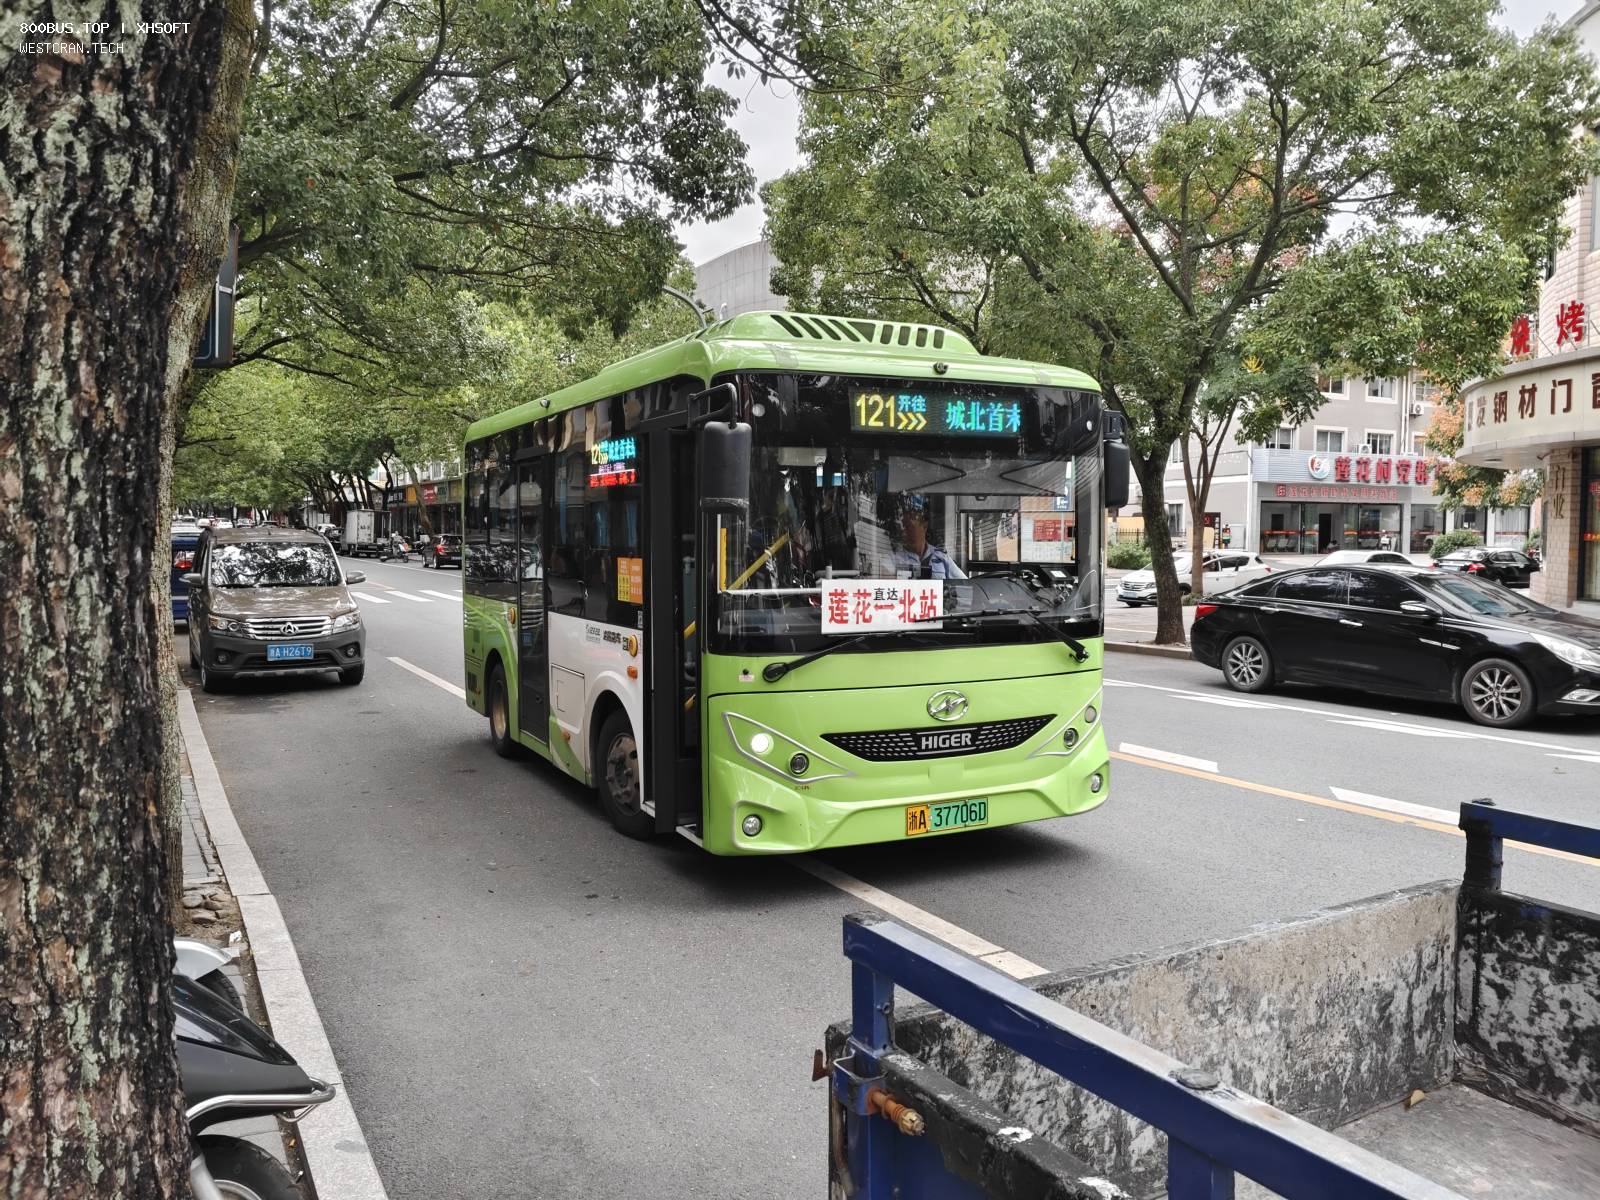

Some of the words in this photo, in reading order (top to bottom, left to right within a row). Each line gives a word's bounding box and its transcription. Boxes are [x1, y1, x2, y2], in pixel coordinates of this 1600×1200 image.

[856, 394, 895, 428] 121
[897, 394, 927, 413] 开往
[828, 588, 873, 625] 莲花
[898, 588, 938, 624] 北站
[873, 587, 899, 601] 直达
[921, 732, 972, 750] HIGER
[933, 801, 987, 828] 37706D
